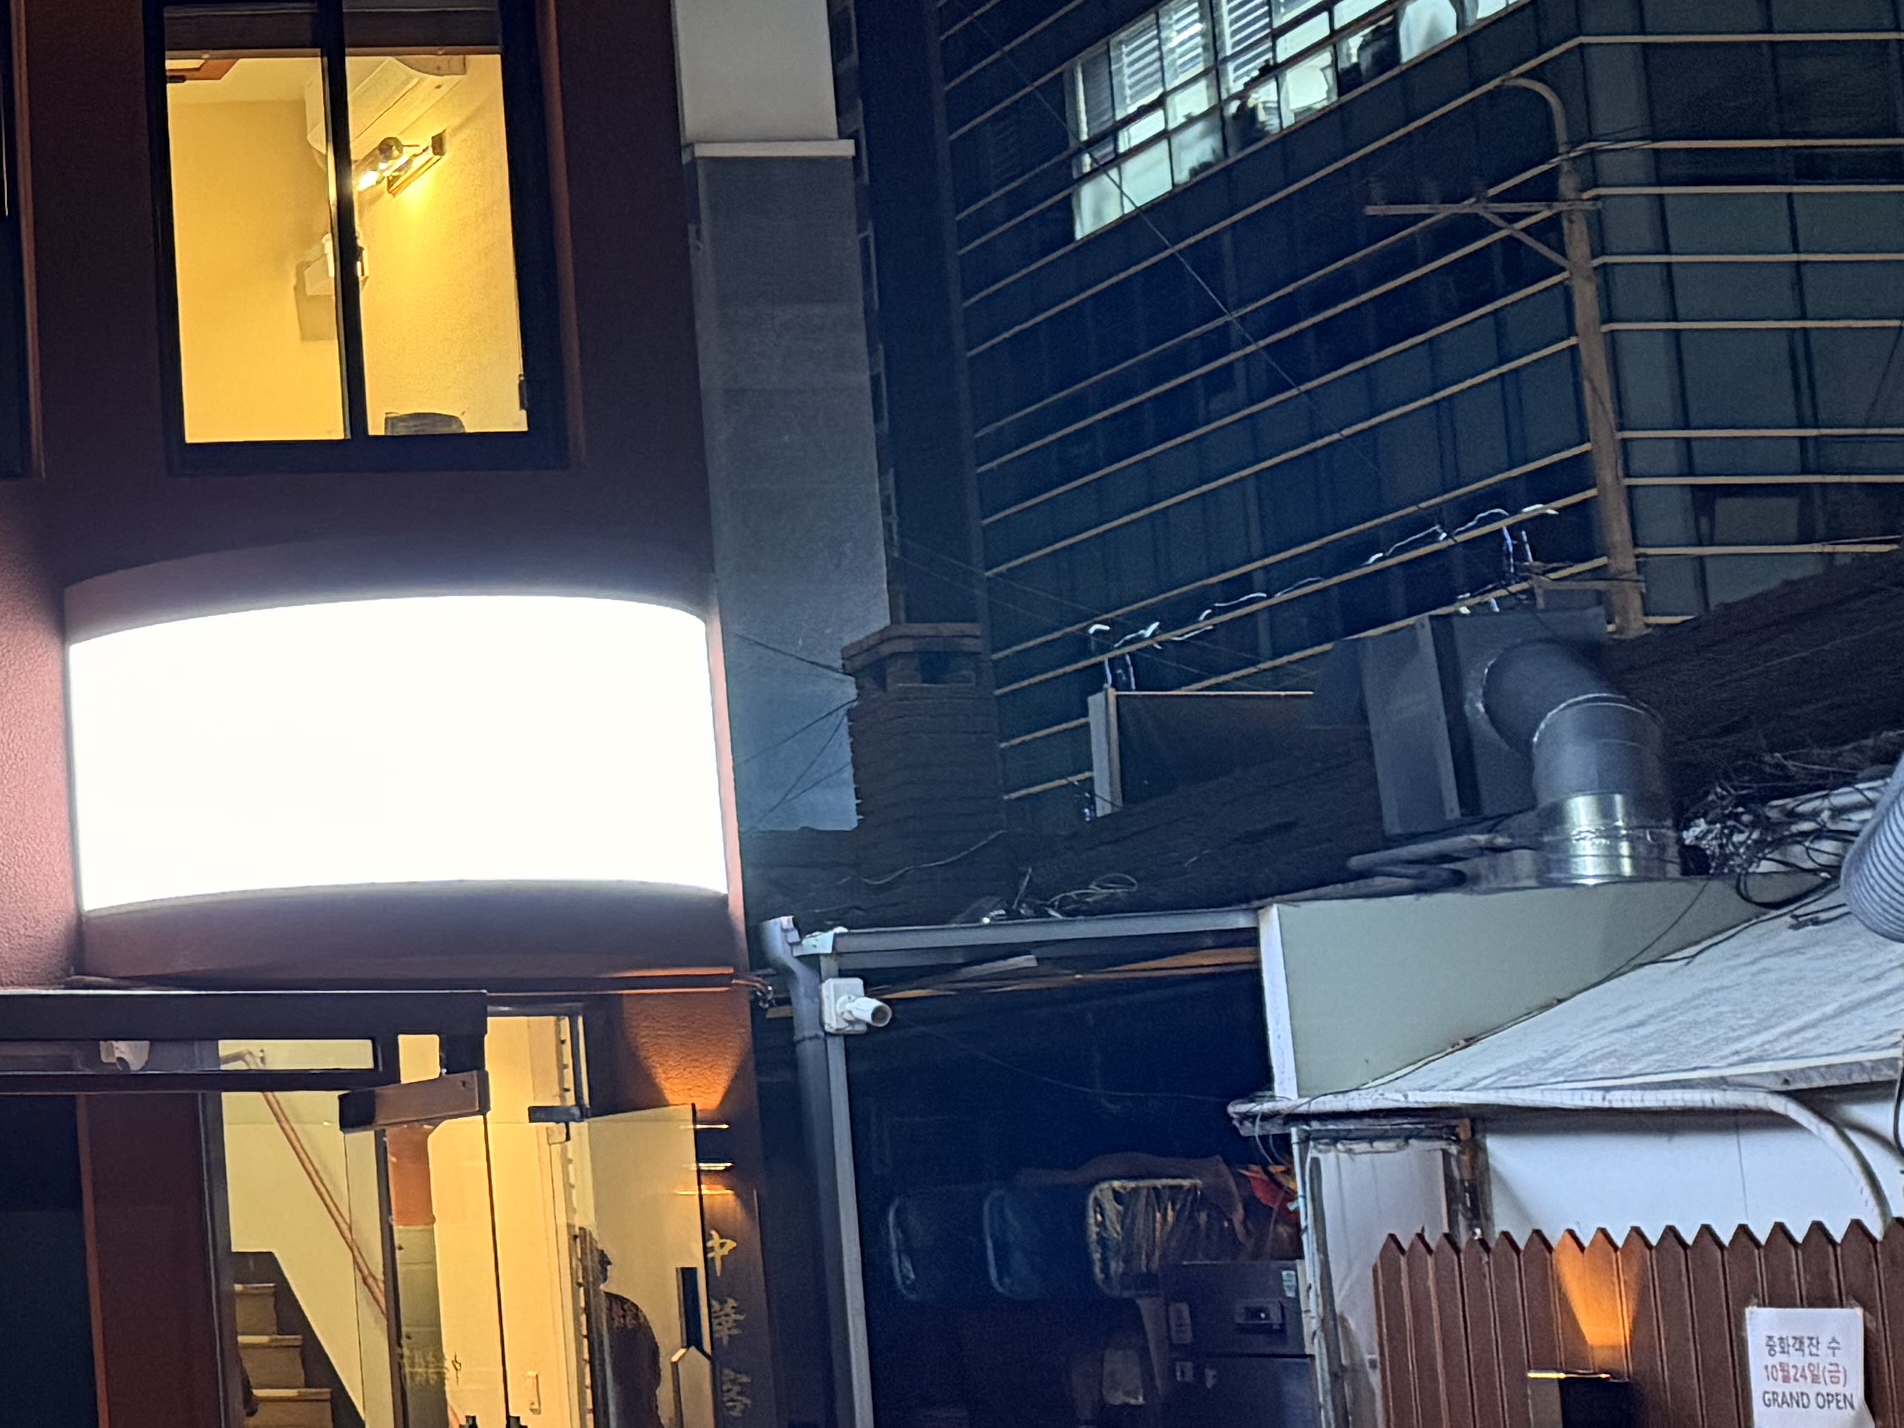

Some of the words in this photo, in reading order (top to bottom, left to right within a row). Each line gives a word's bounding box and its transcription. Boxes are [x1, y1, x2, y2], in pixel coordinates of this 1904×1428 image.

[1765, 1335, 1820, 1358] 중화객잔
[1827, 1336, 1841, 1358] 수
[1762, 1390, 1811, 1410] GRAND
[1815, 1391, 1856, 1411] OPEN
